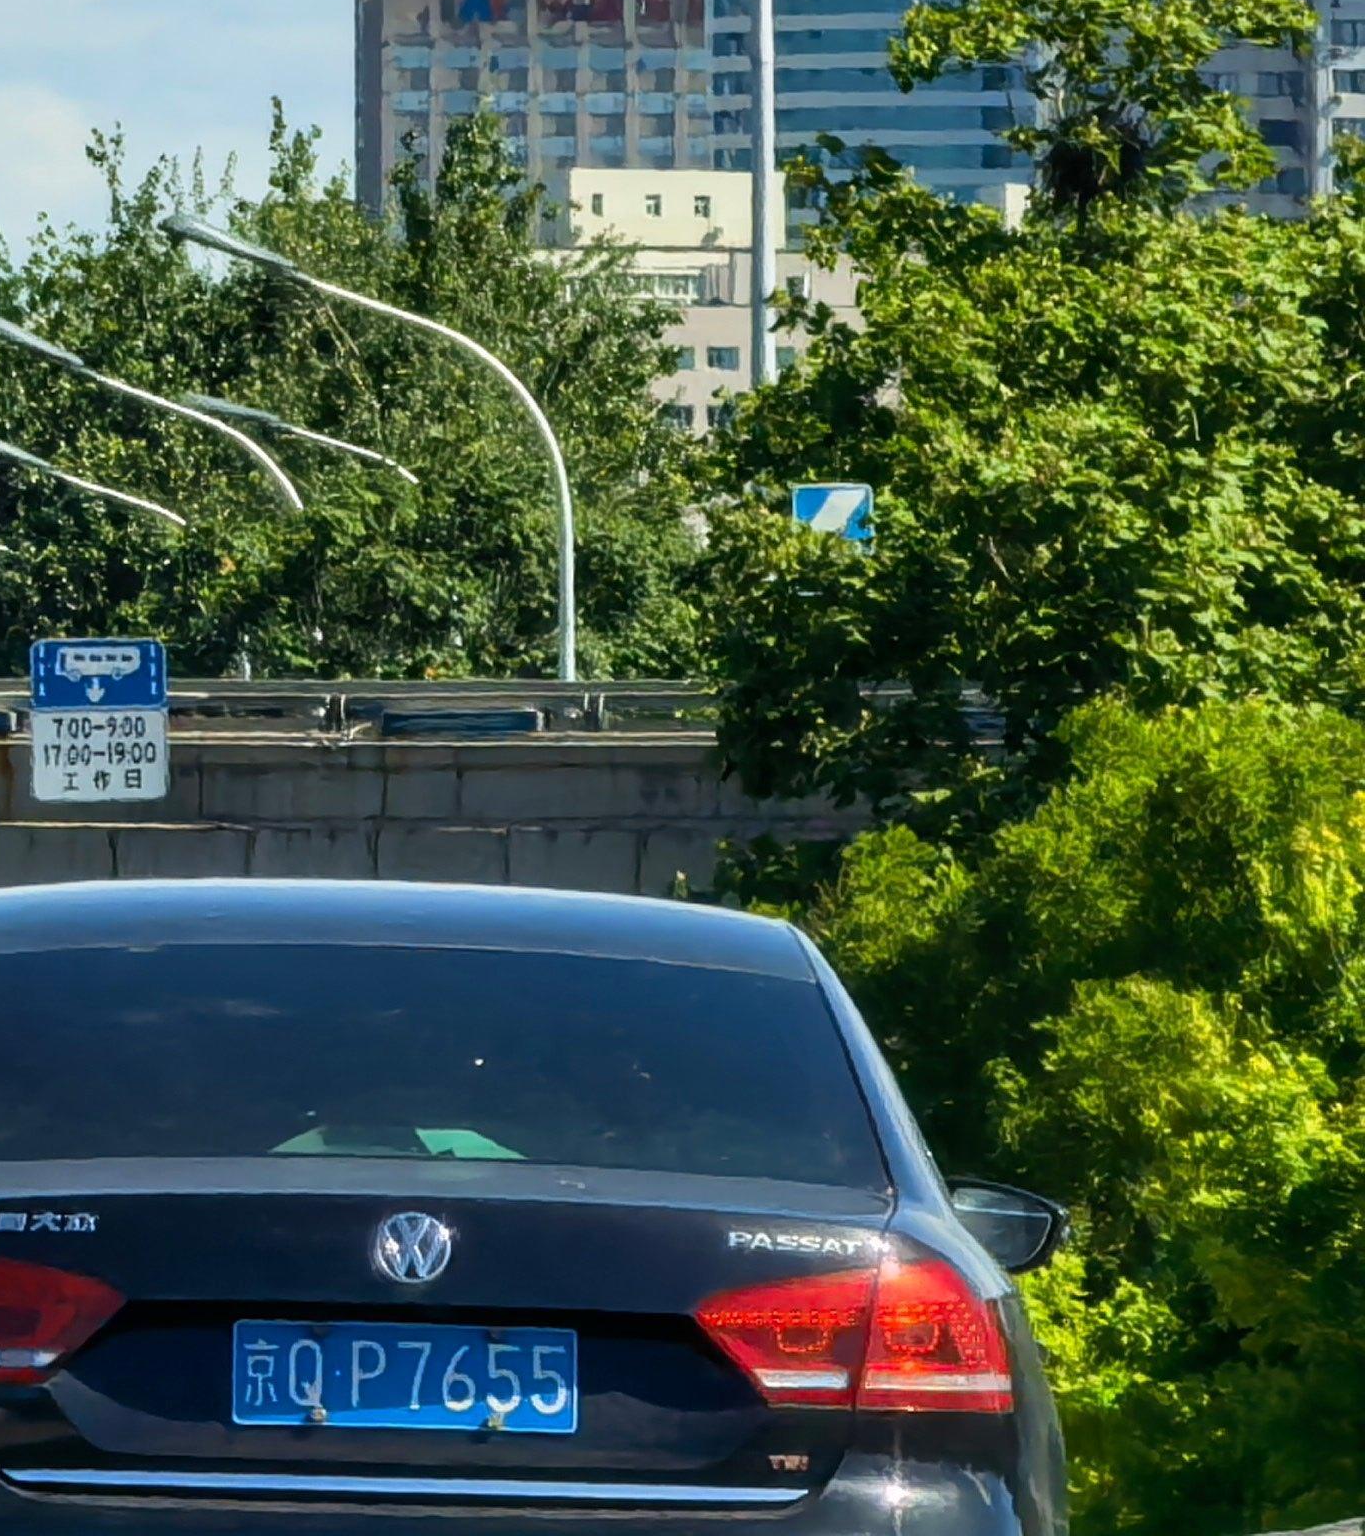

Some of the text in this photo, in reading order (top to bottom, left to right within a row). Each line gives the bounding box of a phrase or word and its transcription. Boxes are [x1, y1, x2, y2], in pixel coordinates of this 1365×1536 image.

[63, 768, 142, 791] 工作日
[727, 1230, 862, 1256] PASSAT
